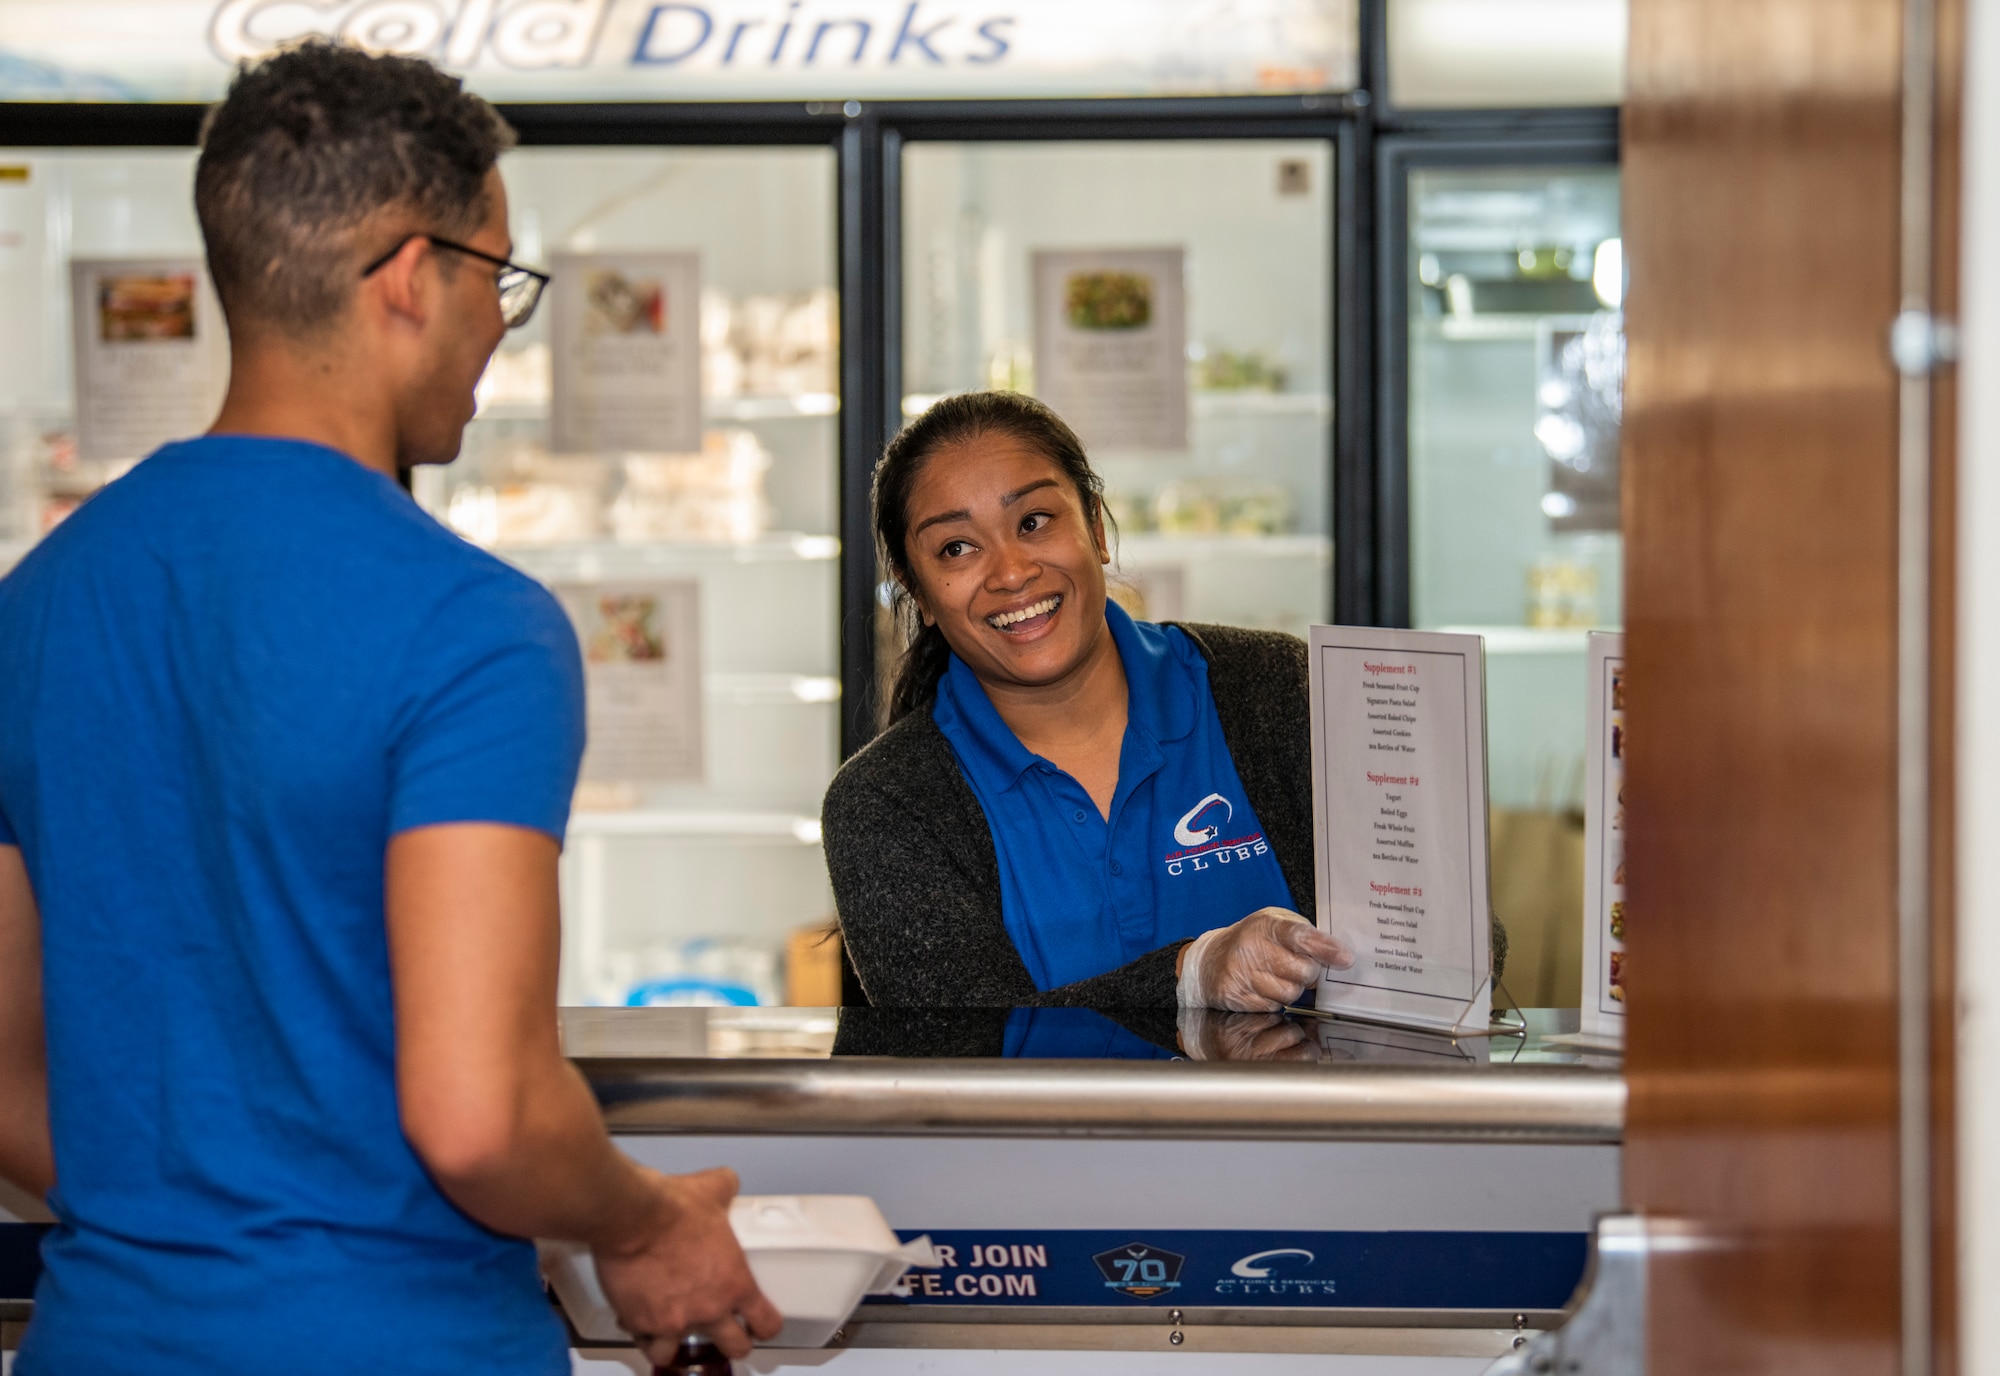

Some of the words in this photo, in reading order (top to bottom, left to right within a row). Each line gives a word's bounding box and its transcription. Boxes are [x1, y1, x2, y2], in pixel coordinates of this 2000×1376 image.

[209, 0, 615, 68] Cold
[629, 0, 1018, 69] Drinks
[1364, 660, 1404, 676] Supplement
[1408, 664, 1416, 675] #1
[1363, 681, 1375, 689] Fresh
[1376, 682, 1395, 691] Seasonal
[1396, 683, 1408, 692] Fruit
[1409, 684, 1420, 694] Cup
[1367, 697, 1387, 706] Signature
[1389, 698, 1401, 706] Pasta
[1402, 699, 1416, 707] Salad
[1368, 712, 1386, 720] Assorted
[1388, 713, 1401, 721] Baked
[1402, 714, 1416, 724] Chips
[1373, 728, 1392, 736] Assorted
[1393, 729, 1411, 737] Cookies
[1378, 743, 1393, 751] Bottles
[1401, 745, 1416, 753] Water
[1366, 771, 1407, 786] Supplement
[1409, 776, 1419, 786] #2
[1385, 793, 1401, 803] Yogurt
[1381, 807, 1395, 816] Boiled
[1396, 809, 1407, 818] Eggs
[1374, 821, 1387, 830] Fresh
[1387, 823, 1403, 831] Whole
[1403, 825, 1415, 833] Fruit
[1376, 837, 1396, 846] Assorted
[1397, 839, 1414, 848] Muffins
[1165, 851, 1183, 861] AIR
[1168, 841, 1268, 876] CLUBS
[1381, 853, 1398, 861] Bottles
[1404, 855, 1419, 864] Water
[1370, 881, 1410, 896] Supplement
[1412, 886, 1423, 897] #3
[1369, 900, 1381, 909] Fresh
[1382, 902, 1402, 911] Seasonal
[1403, 904, 1414, 913] Fruit
[1415, 906, 1425, 916] Cup
[1377, 916, 1389, 925] Small
[1391, 918, 1405, 926] Green
[1406, 920, 1418, 928] Salad
[1380, 932, 1399, 941] Assorted
[1375, 947, 1394, 955] Assorted
[1395, 949, 1408, 958] Baked
[1409, 950, 1423, 961] Chips
[1384, 962, 1401, 971] Bottles
[1408, 965, 1423, 974] Water
[970, 1245, 1048, 1268] JOIN
[1113, 1259, 1166, 1281] 70
[901, 1274, 1037, 1297] FE.COM
[1215, 1284, 1336, 1294] CLUBS
